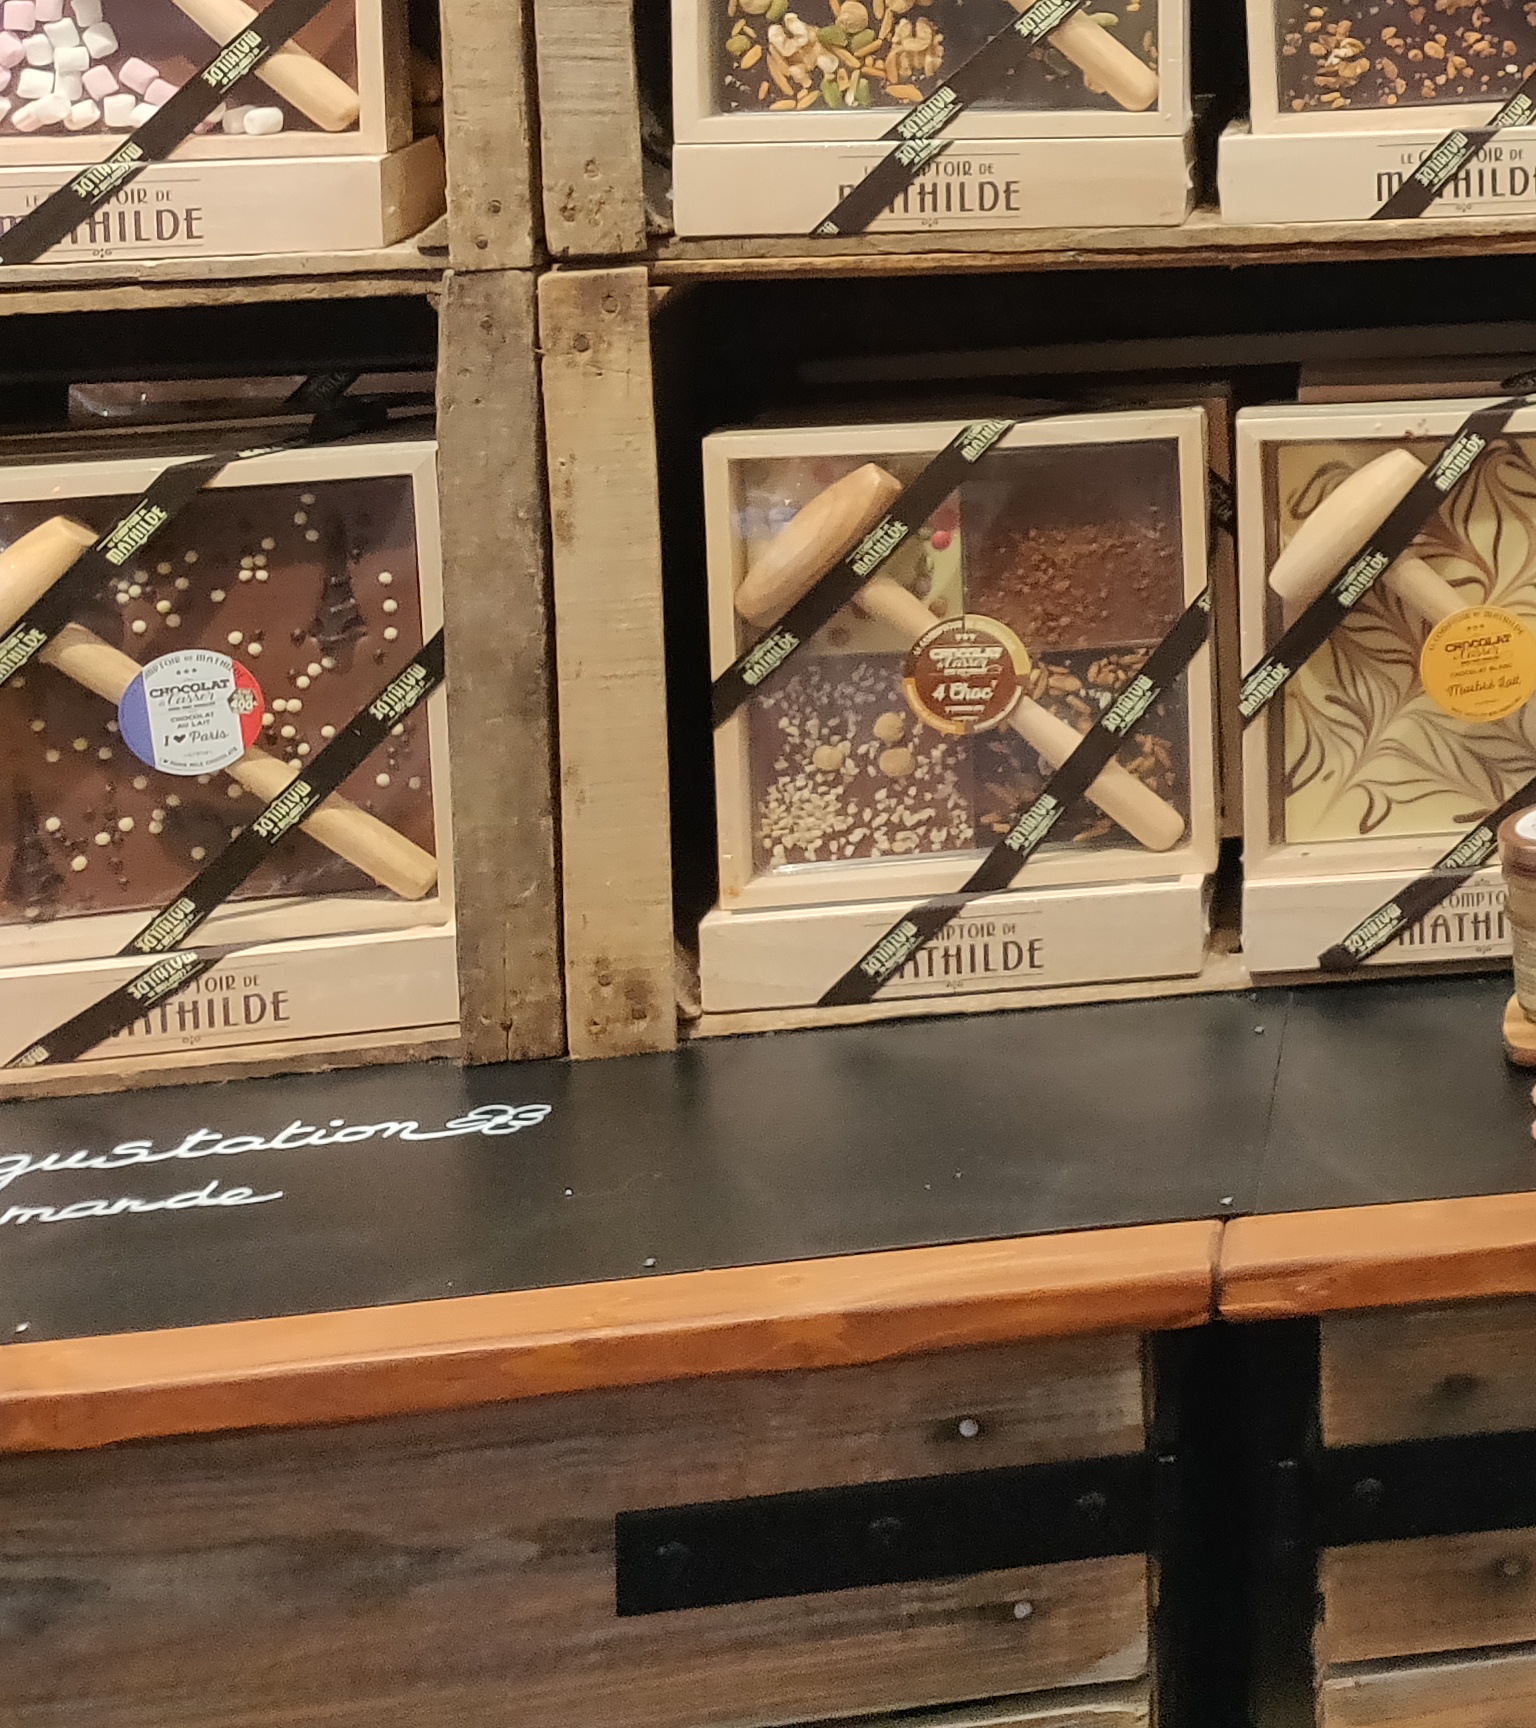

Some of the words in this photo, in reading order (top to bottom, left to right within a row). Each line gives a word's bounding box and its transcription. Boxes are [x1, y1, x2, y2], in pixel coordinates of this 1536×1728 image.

[202, 29, 262, 87] MATHILDE
[1435, 433, 1486, 492] MATHILDE
[106, 505, 167, 565] MATHILDE
[149, 679, 230, 699] CHOCOLAT
